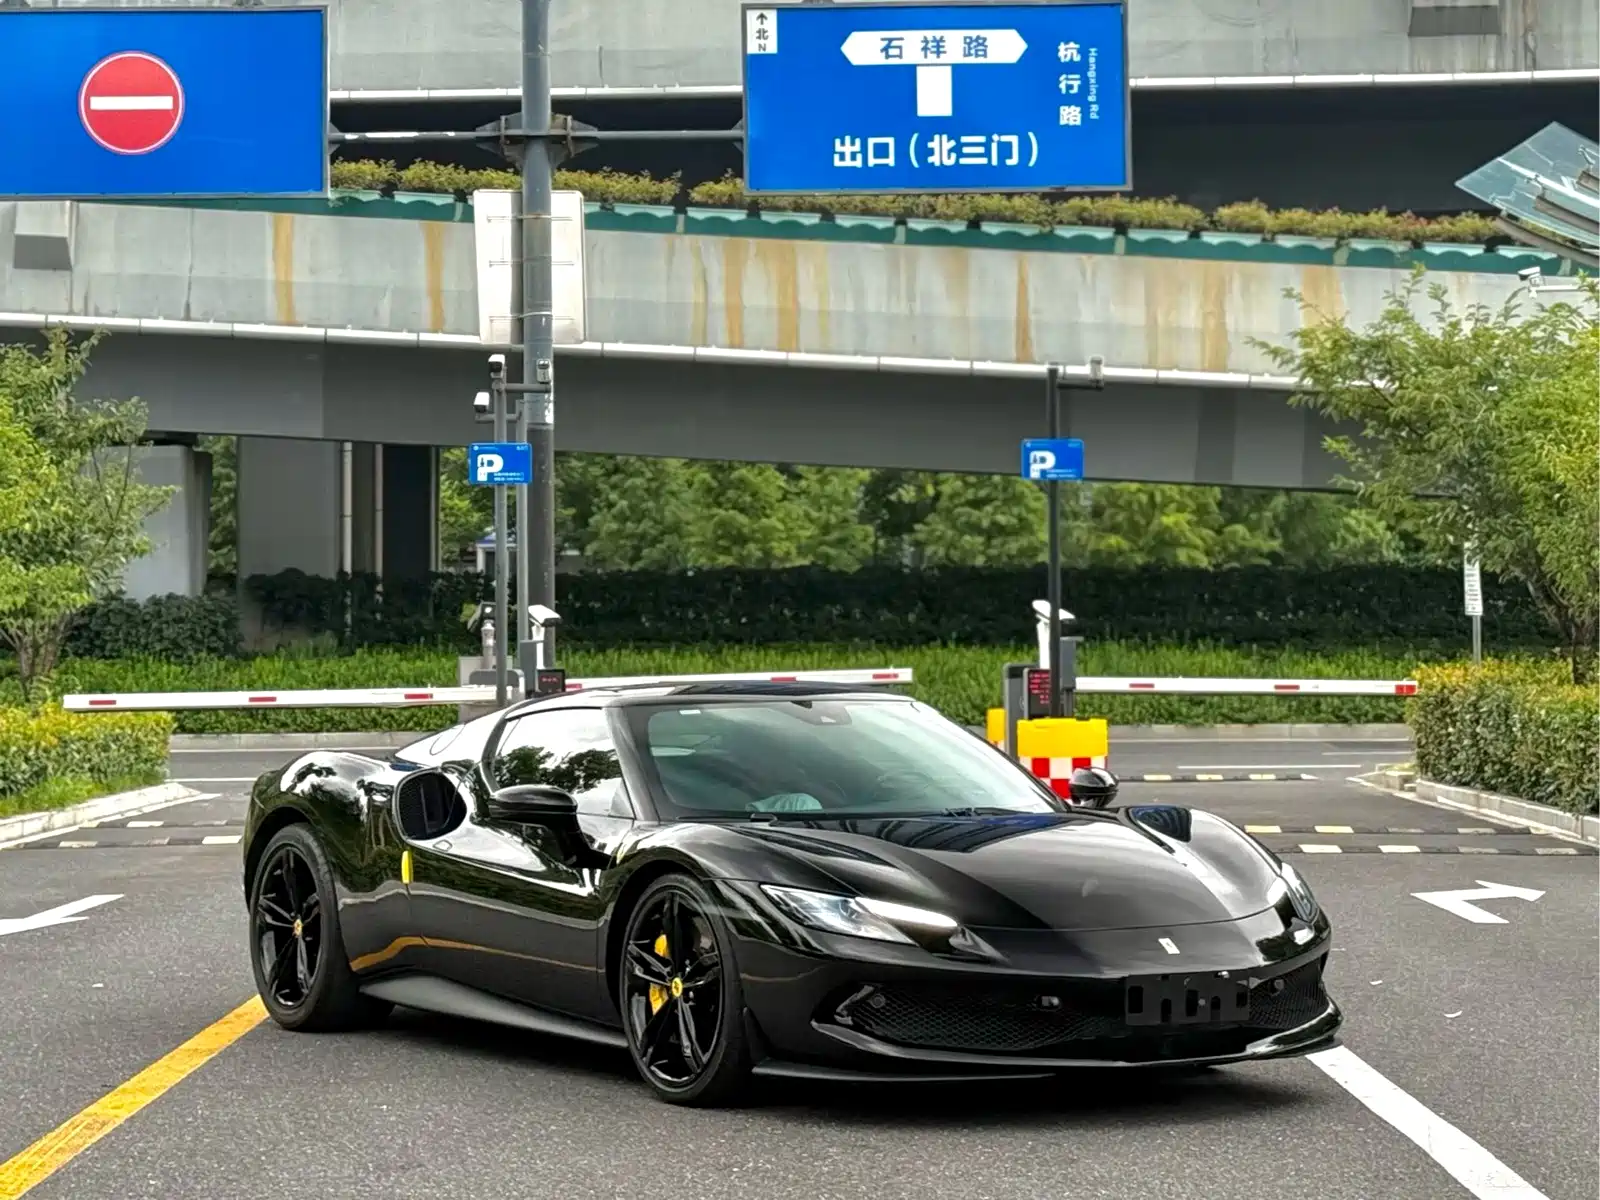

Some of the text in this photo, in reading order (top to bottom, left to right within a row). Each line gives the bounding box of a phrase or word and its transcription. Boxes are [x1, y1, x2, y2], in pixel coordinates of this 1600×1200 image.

[756, 28, 769, 40] 北
[758, 43, 767, 52] N
[880, 35, 988, 59] 石祥路
[1058, 42, 1082, 126] 杭行路
[1087, 48, 1100, 119] Hangxing Rd
[833, 131, 1039, 168] 出口（北三门）
[476, 453, 504, 482] P
[1029, 450, 1056, 480] P
